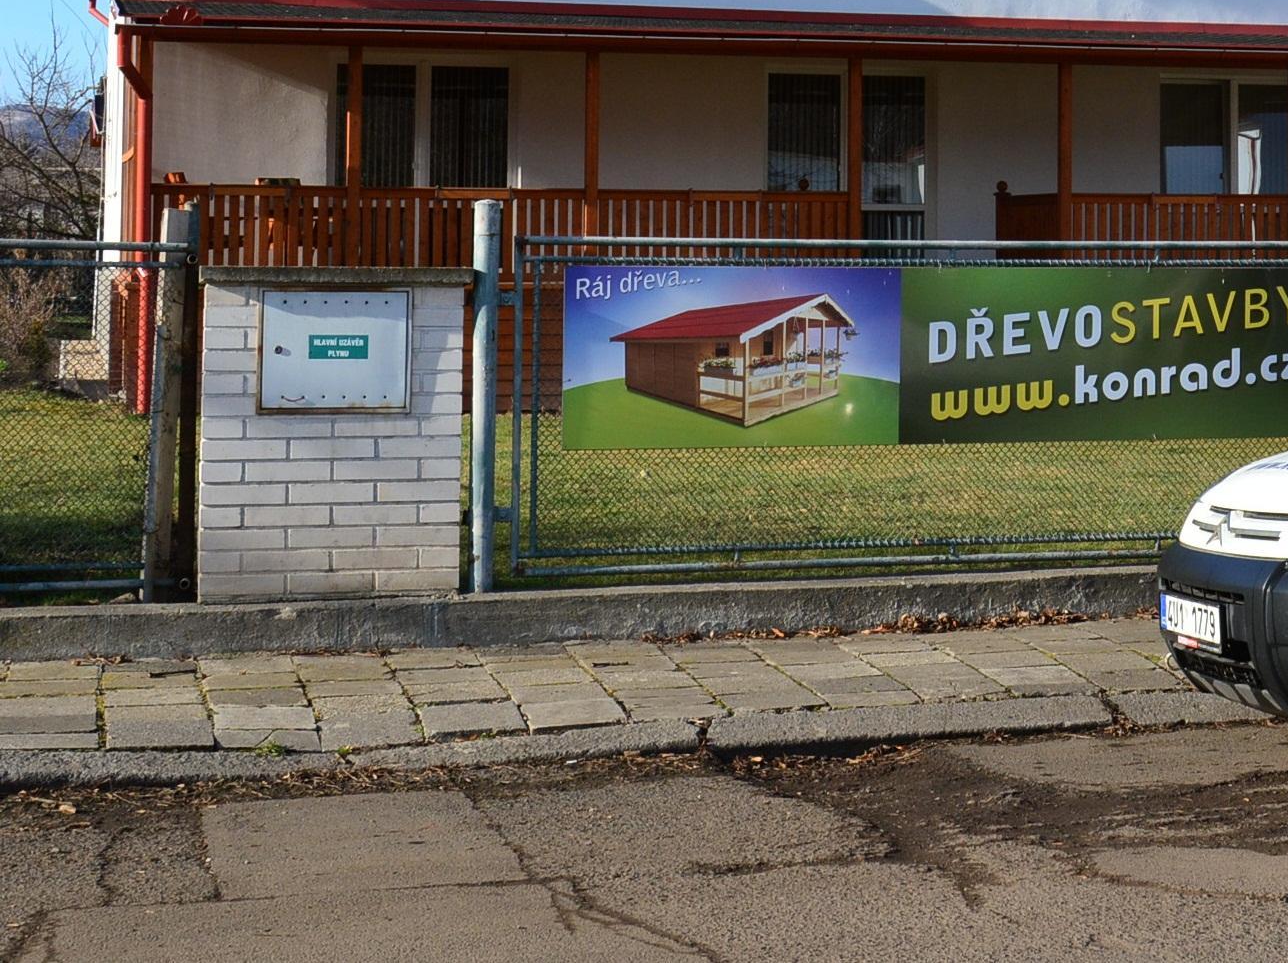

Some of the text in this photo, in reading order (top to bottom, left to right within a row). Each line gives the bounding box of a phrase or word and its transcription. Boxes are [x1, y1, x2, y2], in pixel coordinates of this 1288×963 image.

[576, 269, 702, 300] Ráj dřeva...
[313, 337, 364, 347] HLAVNÍ UZÁVĚR
[327, 349, 350, 357] PLYNU
[1167, 599, 1216, 639] 4U1 1779
